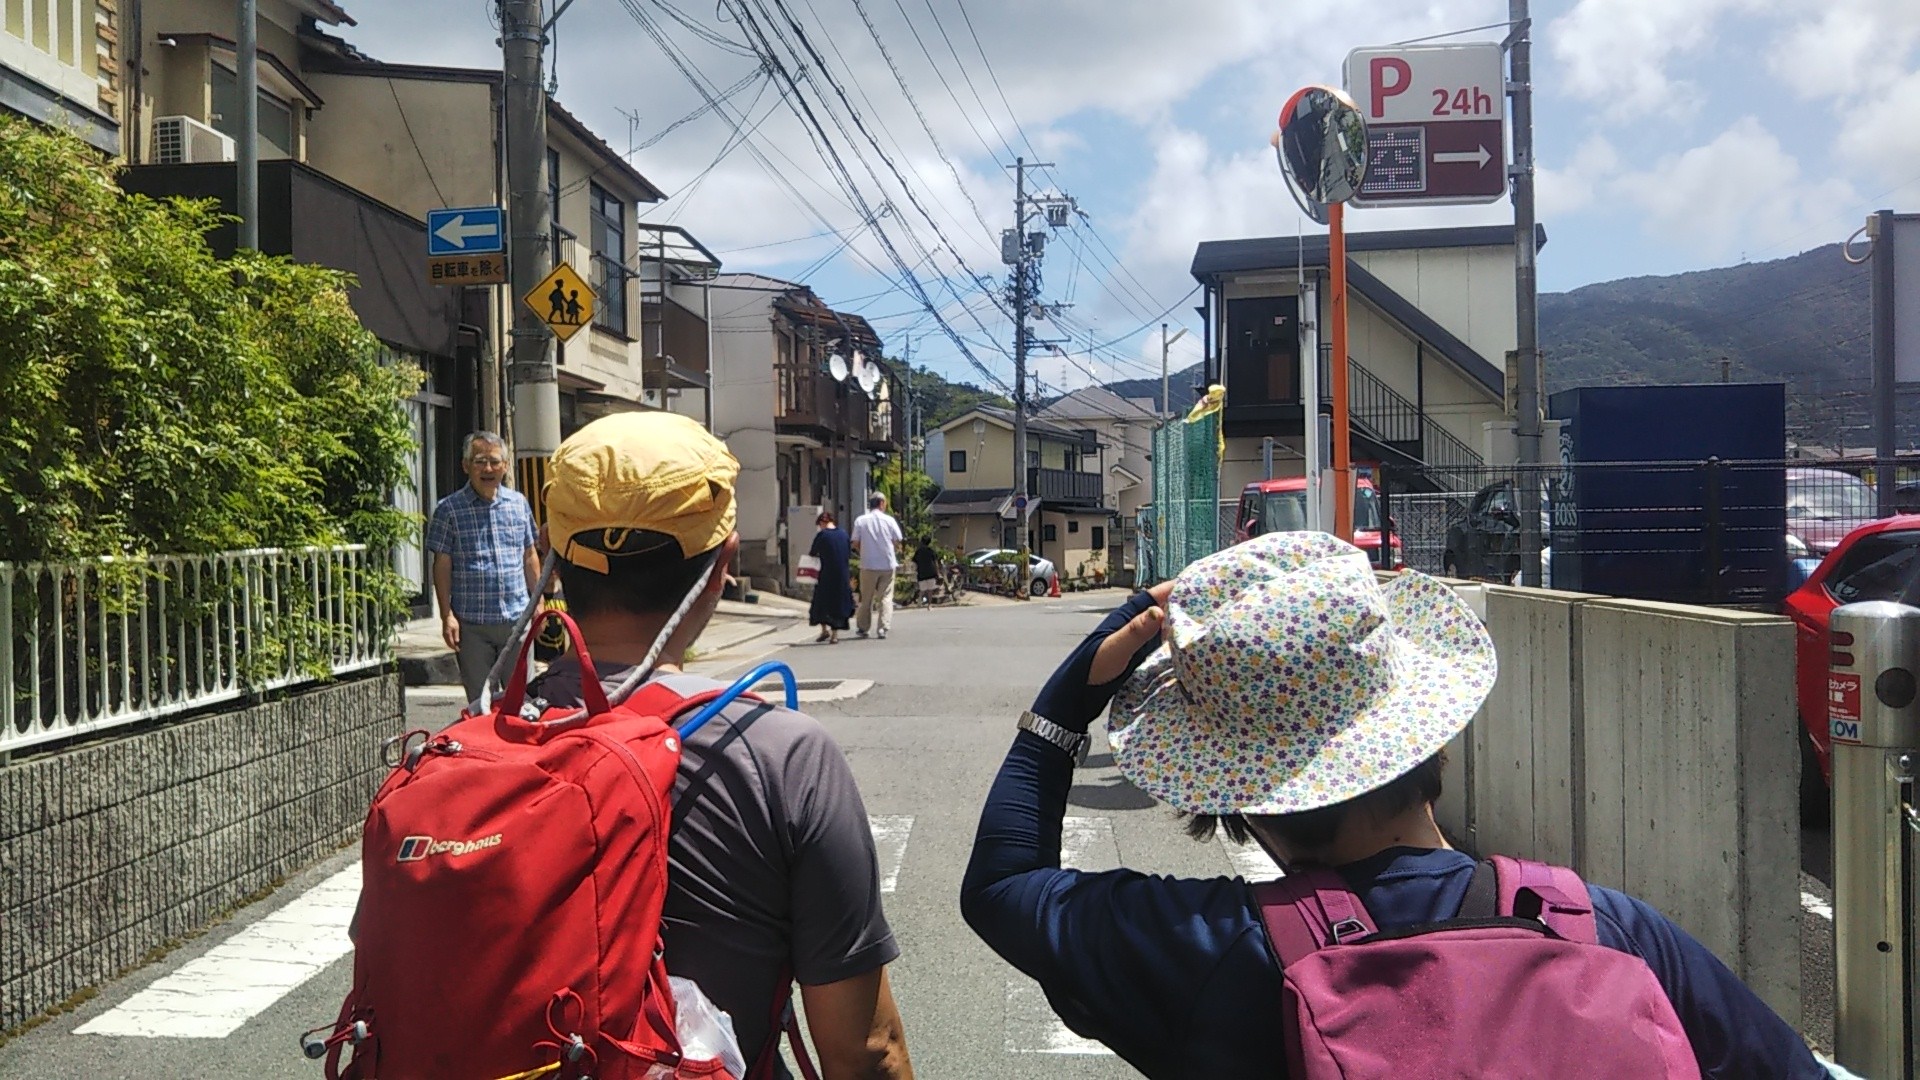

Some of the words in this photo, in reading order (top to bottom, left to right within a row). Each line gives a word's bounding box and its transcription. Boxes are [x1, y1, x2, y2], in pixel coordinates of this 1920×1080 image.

[1370, 57, 1412, 118] P
[1432, 86, 1492, 116] 24h
[1363, 132, 1421, 190] 空
[432, 260, 501, 279] 自転車を除く
[428, 832, 503, 856] berghaus
